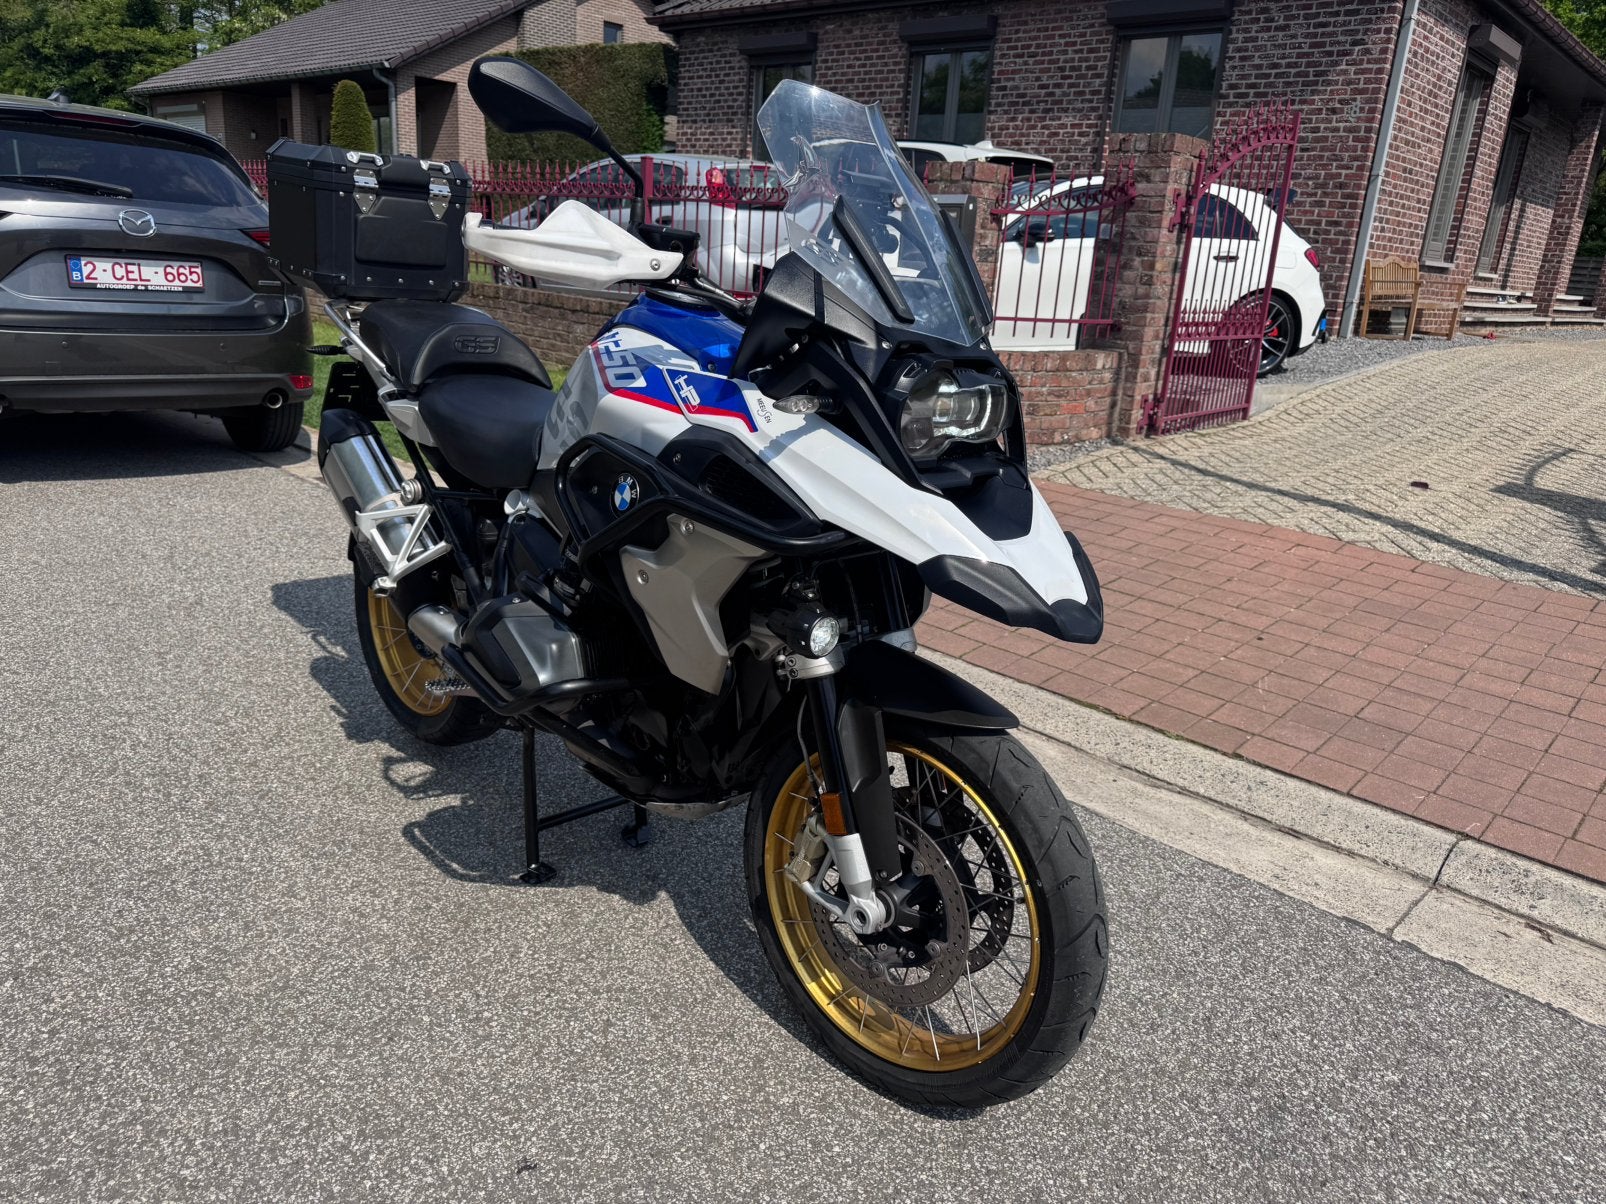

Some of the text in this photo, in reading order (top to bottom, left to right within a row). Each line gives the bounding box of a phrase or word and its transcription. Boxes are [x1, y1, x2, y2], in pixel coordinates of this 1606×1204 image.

[73, 271, 82, 280] B
[454, 335, 500, 354] GS
[674, 374, 701, 408] HP
[757, 397, 773, 424] MEEUSEN
